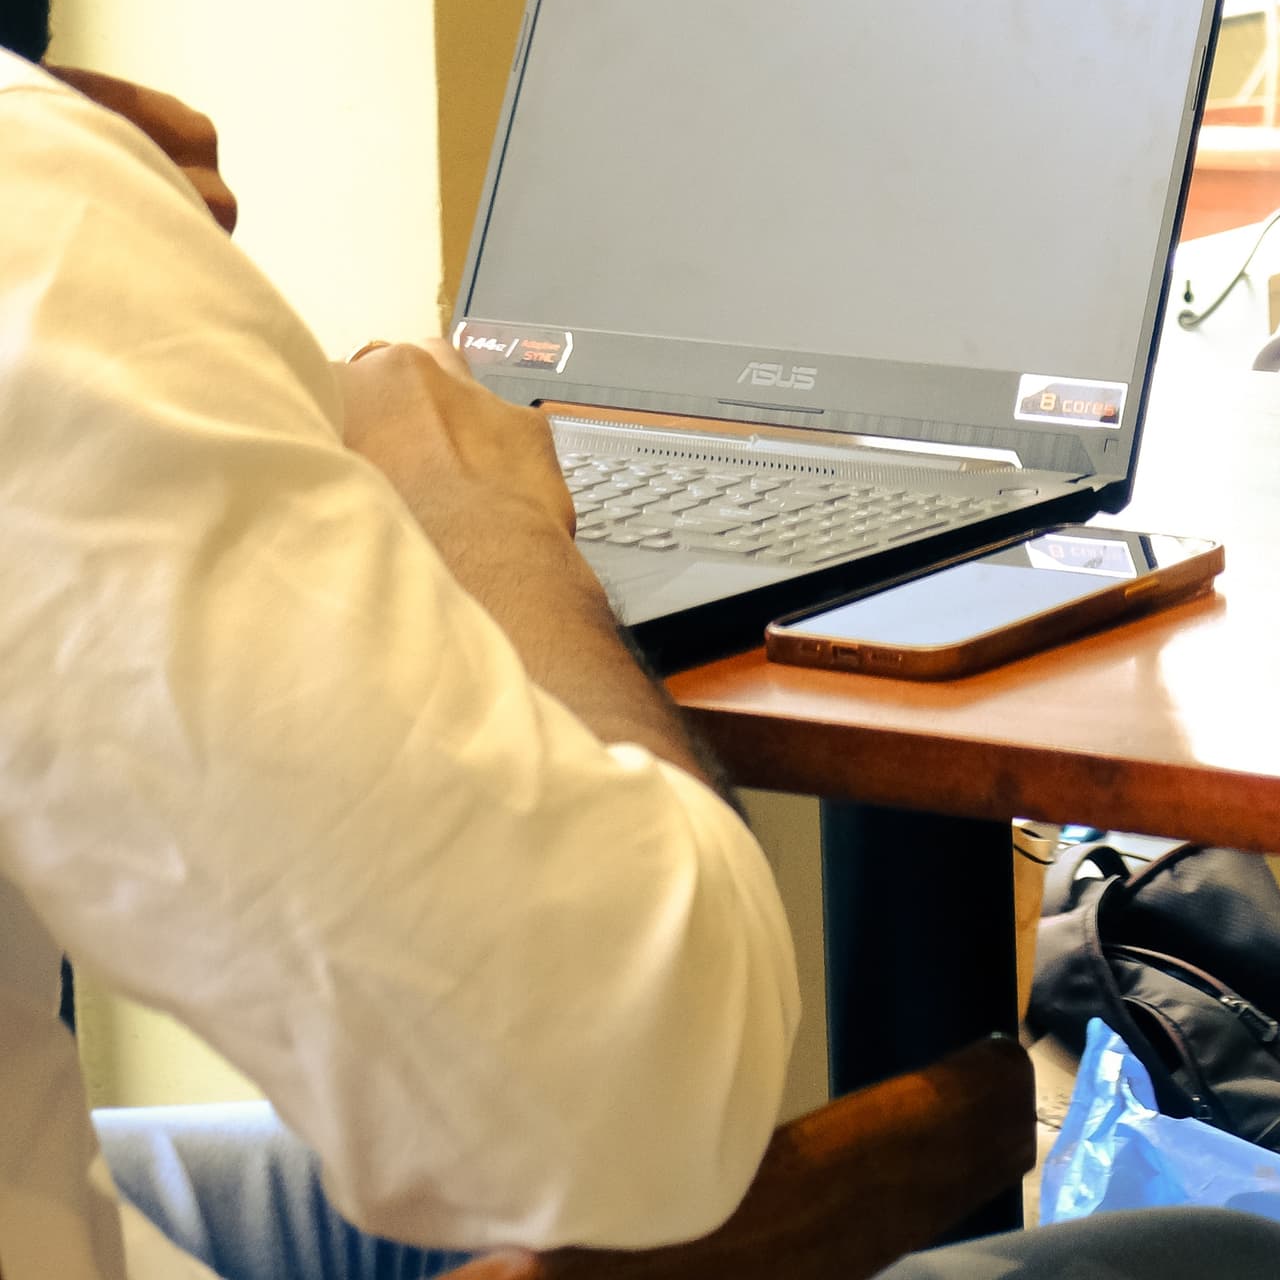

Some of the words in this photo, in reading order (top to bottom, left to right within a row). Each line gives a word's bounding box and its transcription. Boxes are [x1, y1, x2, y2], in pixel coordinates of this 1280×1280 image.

[736, 361, 818, 391] ASUS
[1040, 392, 1057, 411] 8
[1062, 399, 1115, 417] cores
